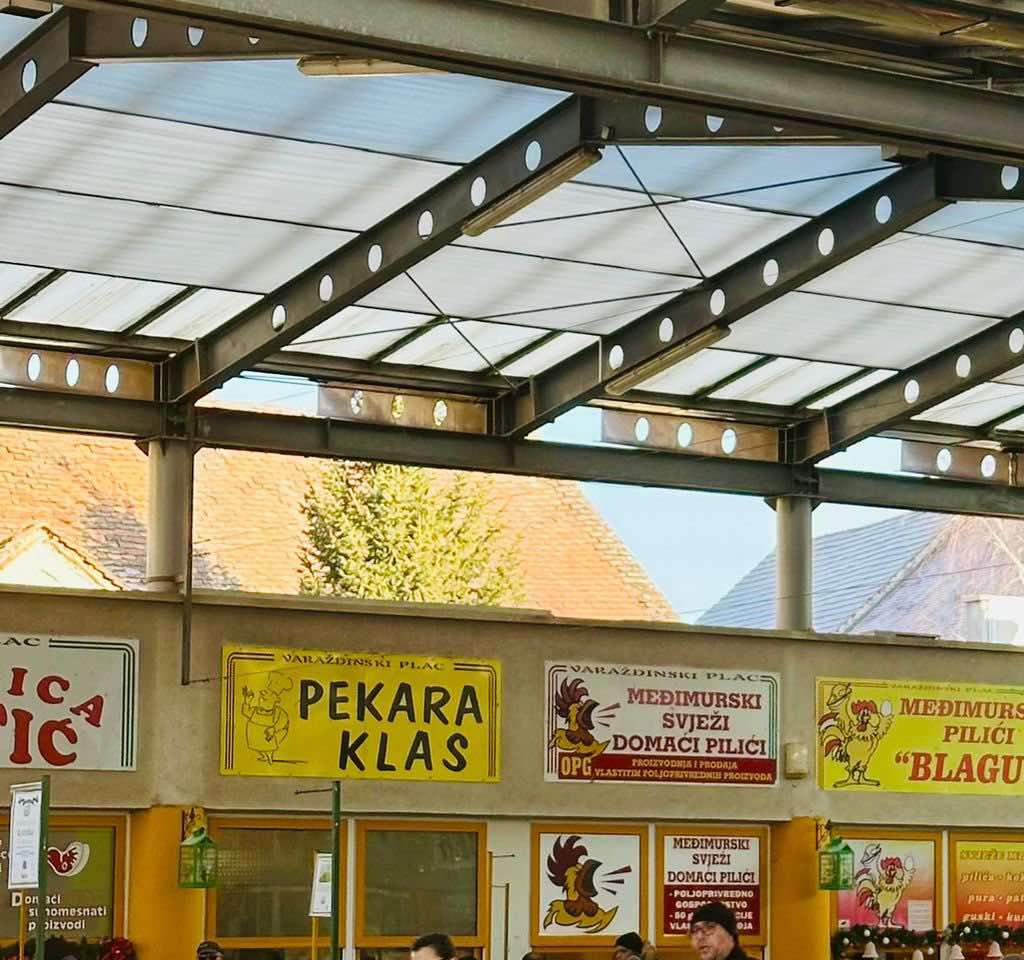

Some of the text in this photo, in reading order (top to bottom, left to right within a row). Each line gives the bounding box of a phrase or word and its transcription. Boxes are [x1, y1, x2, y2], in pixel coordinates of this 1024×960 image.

[282, 653, 445, 671] VARAŽDINSKI PLAC
[570, 664, 760, 682] VARAŽDINSKI PLAC
[299, 679, 483, 726] PEKARA
[627, 687, 762, 709] MEĐIMURSKI
[662, 710, 730, 733] SVJEŽI
[612, 731, 766, 756] DOMAĆI PILIĆI
[942, 721, 1016, 745] PILIĆI
[338, 730, 468, 772] KLAS
[560, 756, 592, 776] OPG
[672, 838, 750, 850] MEĐIMURSKI
